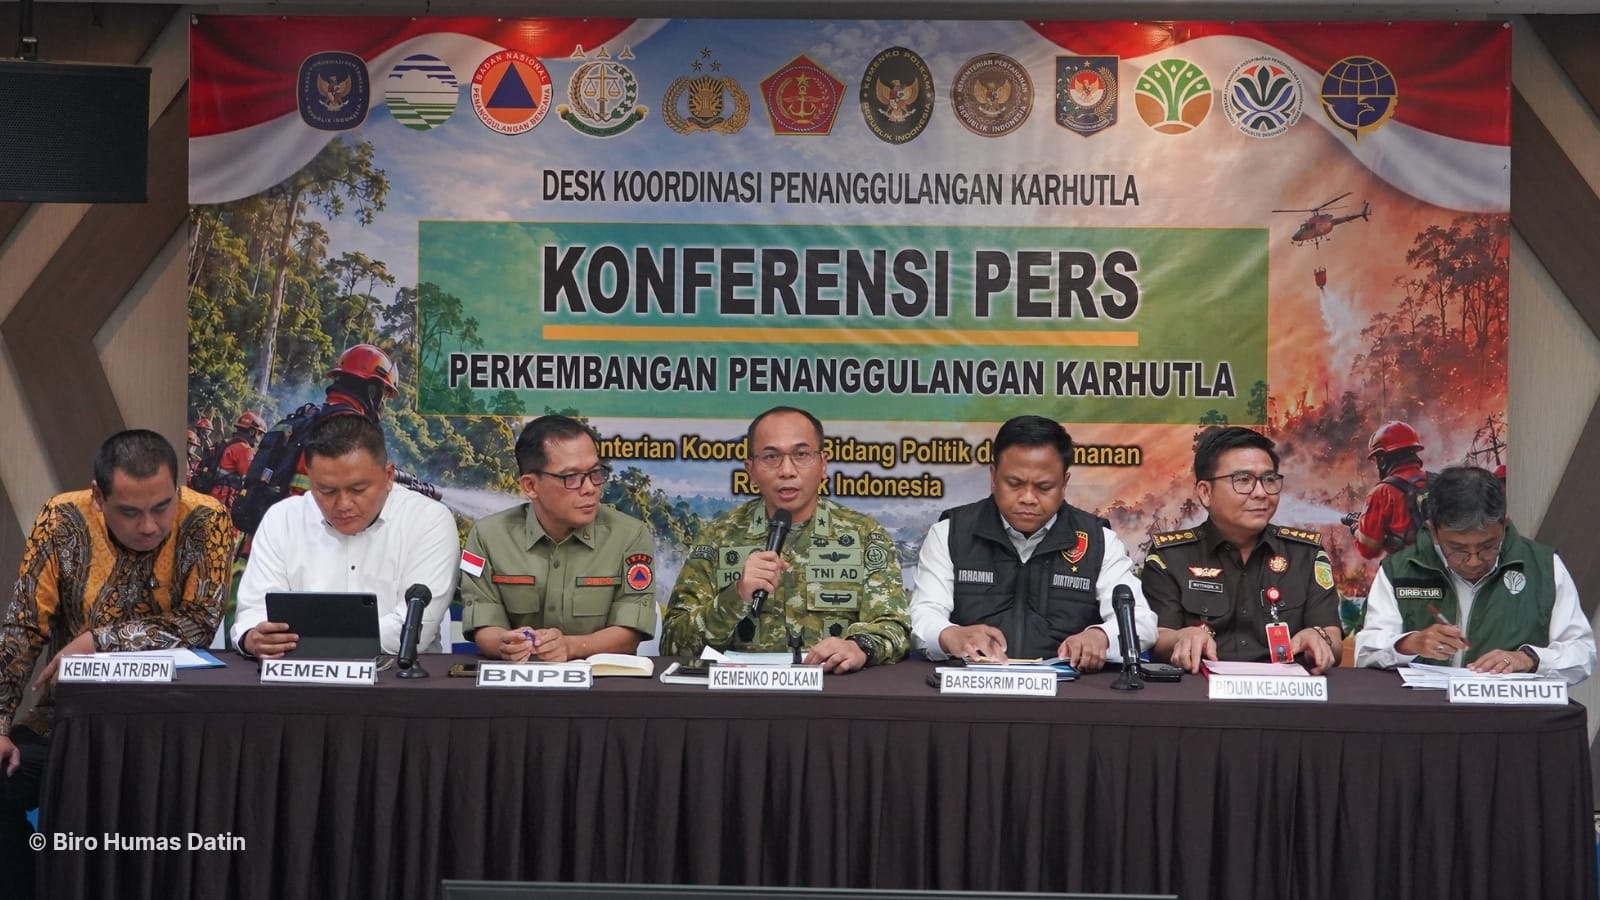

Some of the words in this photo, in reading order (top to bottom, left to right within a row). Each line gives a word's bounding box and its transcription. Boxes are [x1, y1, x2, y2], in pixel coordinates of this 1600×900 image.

[476, 55, 502, 81] BADAN
[506, 52, 548, 82] NASIONAL
[863, 50, 900, 89] KEMENKO
[903, 52, 931, 90] POLKAM
[473, 87, 530, 133] PENANGGULANGAN
[529, 88, 551, 125] BENCANA
[957, 104, 989, 132] REPUBLIK
[991, 105, 1028, 133] INDONESIA
[863, 102, 893, 141] REPUBLIK
[895, 103, 931, 142] INDONESIA
[543, 169, 606, 202] DESK
[613, 170, 762, 203] KOORDINASI
[770, 171, 1003, 205] PENANGGULANGAN
[1011, 173, 1140, 206] KARHUTLA
[543, 245, 949, 318] KONFERENSI
[975, 250, 1139, 320] PERS
[450, 354, 717, 391] PERKEMBANGAN
[729, 357, 1044, 395] PENANGGULANGAN
[1056, 361, 1235, 397] KARHUTLA
[596, 437, 676, 459] nterian
[823, 438, 896, 468] Bidang
[902, 440, 971, 464] Politik
[1073, 446, 1141, 465] manan
[836, 474, 942, 497] Indonesia
[811, 568, 834, 579] TNI
[839, 568, 858, 580] AD
[958, 569, 994, 584] IRHAMNI
[1399, 589, 1440, 598] DIREKTUR
[64, 662, 110, 677] KEMEN
[113, 663, 169, 678] ATR/BPN
[265, 663, 339, 678] KEMEN
[346, 666, 373, 679] LH
[483, 669, 587, 684] BNPB
[713, 671, 768, 686] KEMENKO
[772, 671, 819, 687] POLKAM
[945, 674, 1014, 689] BARESKRIM
[1017, 676, 1052, 691] POLRI
[1215, 680, 1253, 696] PIDUM
[1257, 681, 1323, 697] KEJAGUNG
[1453, 683, 1564, 699] KEMENHUT
